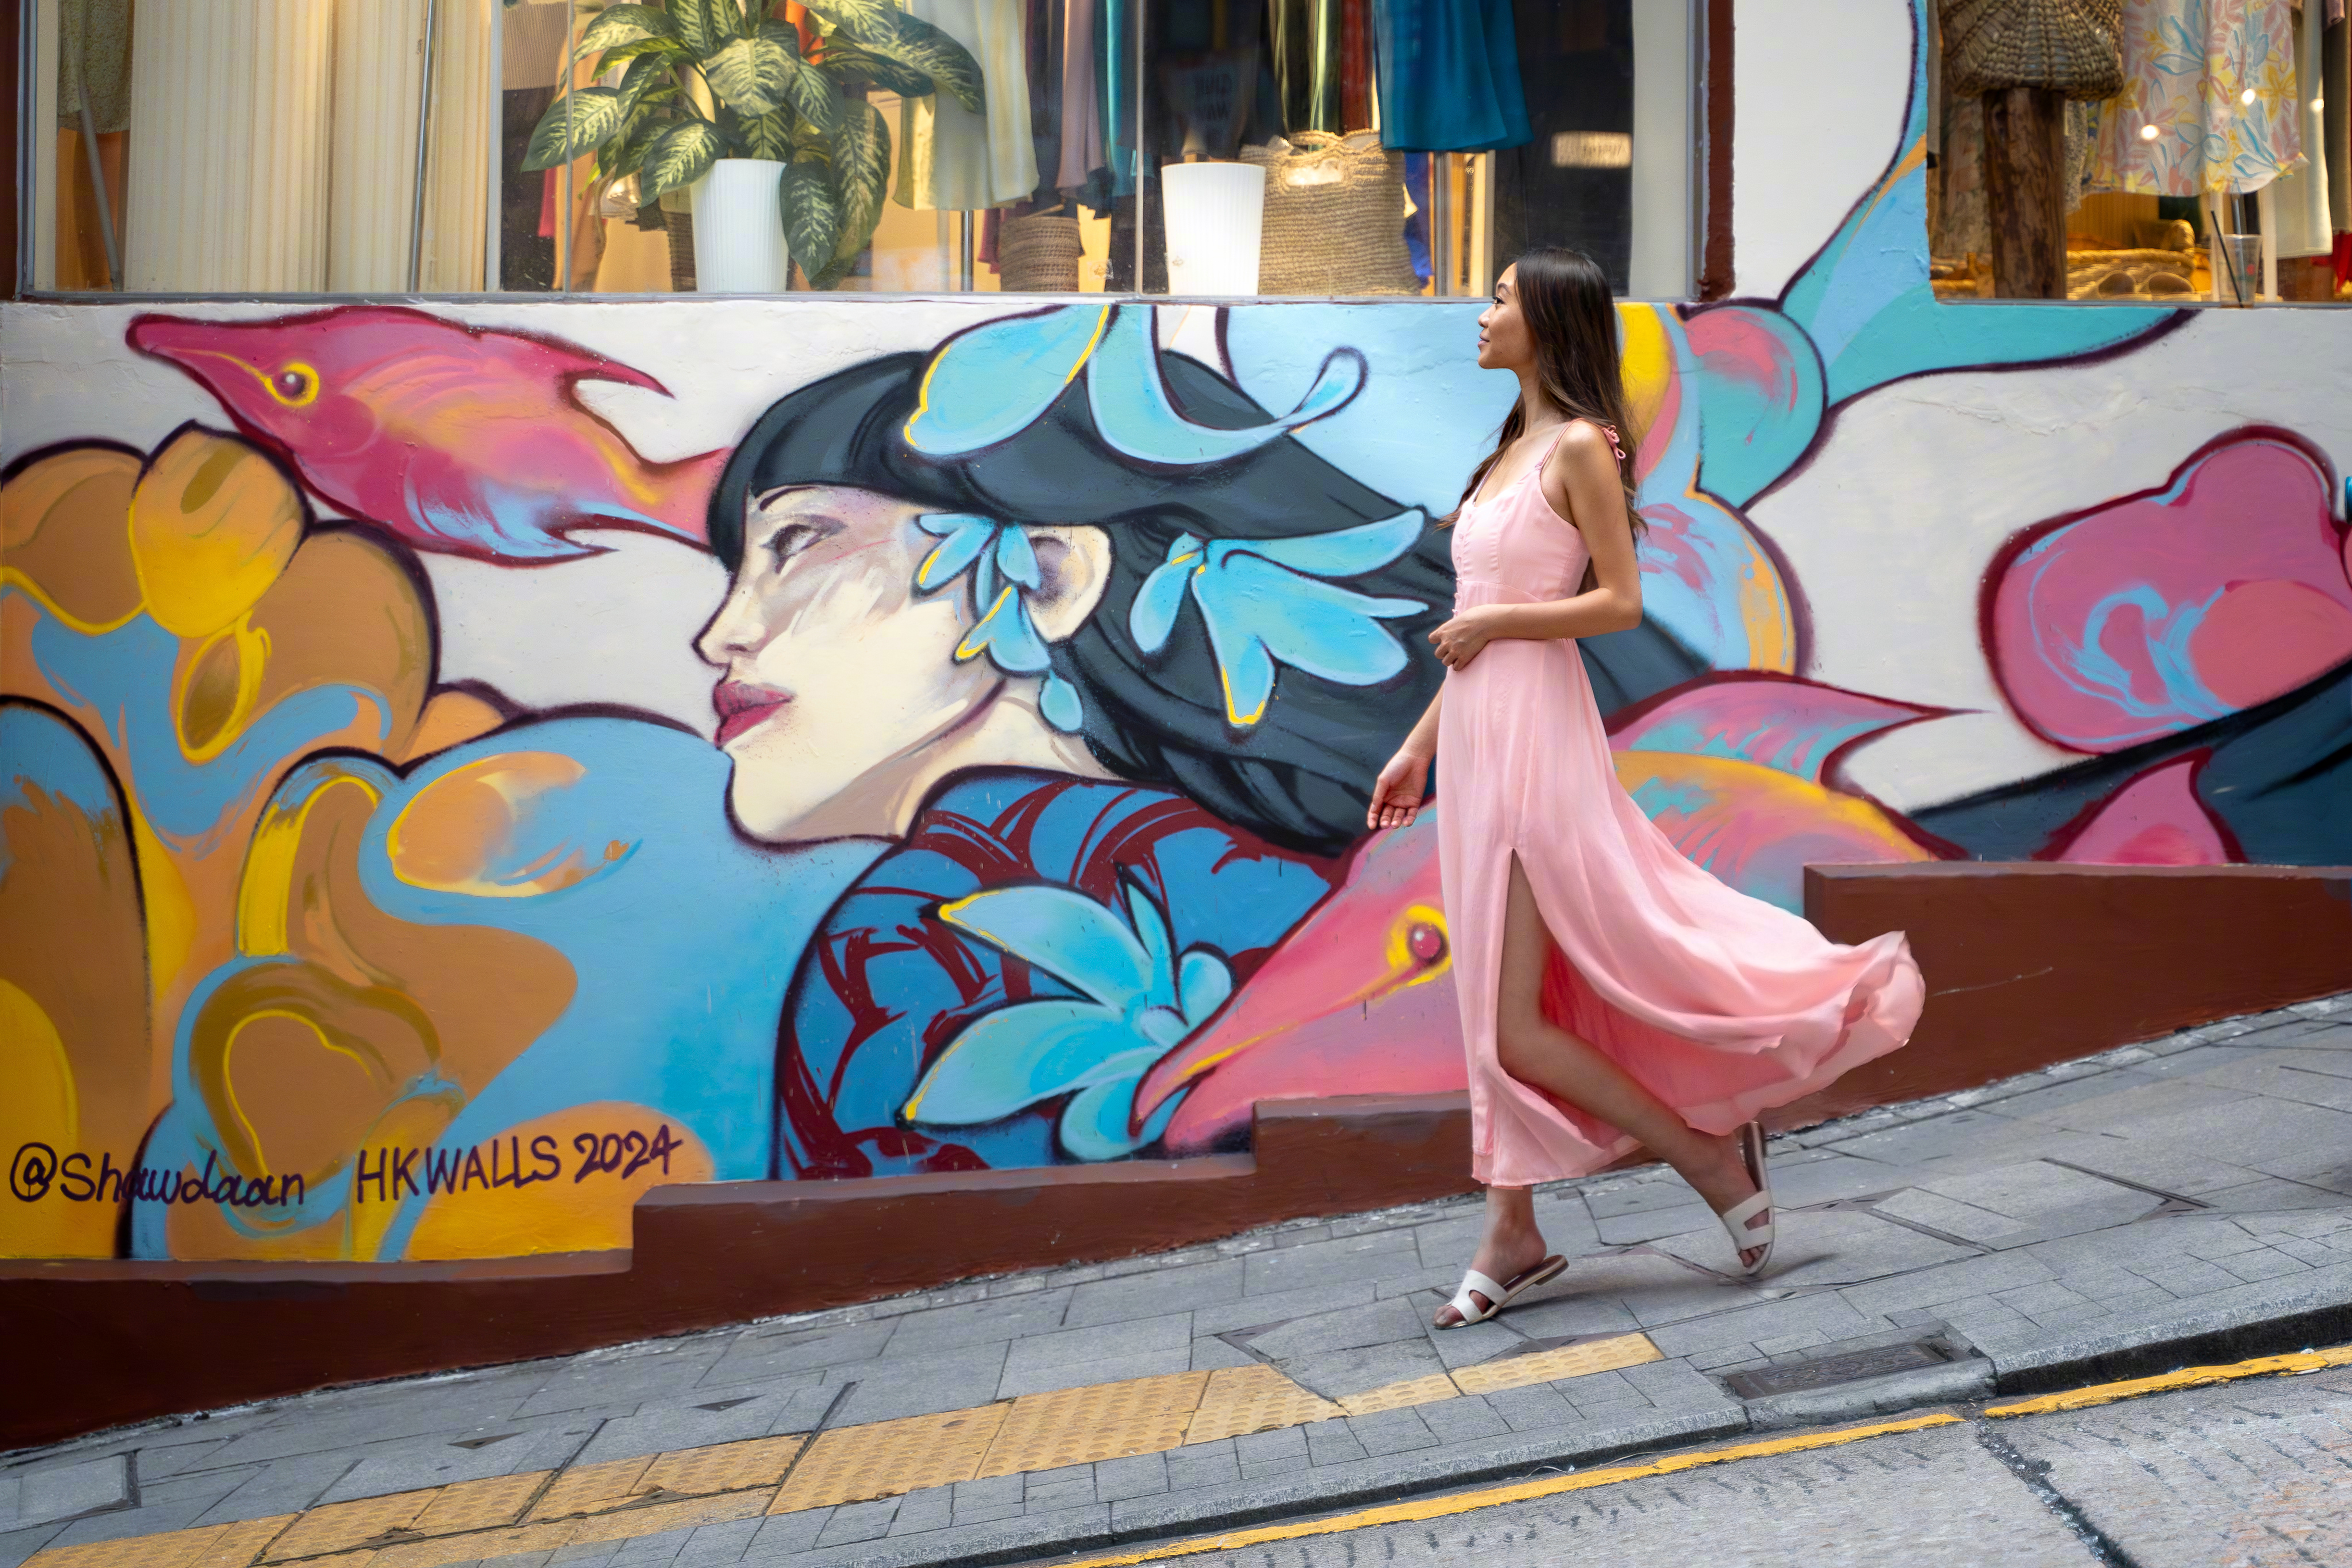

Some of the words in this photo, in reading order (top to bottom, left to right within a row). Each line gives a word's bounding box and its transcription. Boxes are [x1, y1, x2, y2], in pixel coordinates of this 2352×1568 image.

[10, 1142, 305, 1206] @Shawdaan
[357, 1136, 562, 1203] HKWALLS
[573, 1124, 683, 1183] 2024
